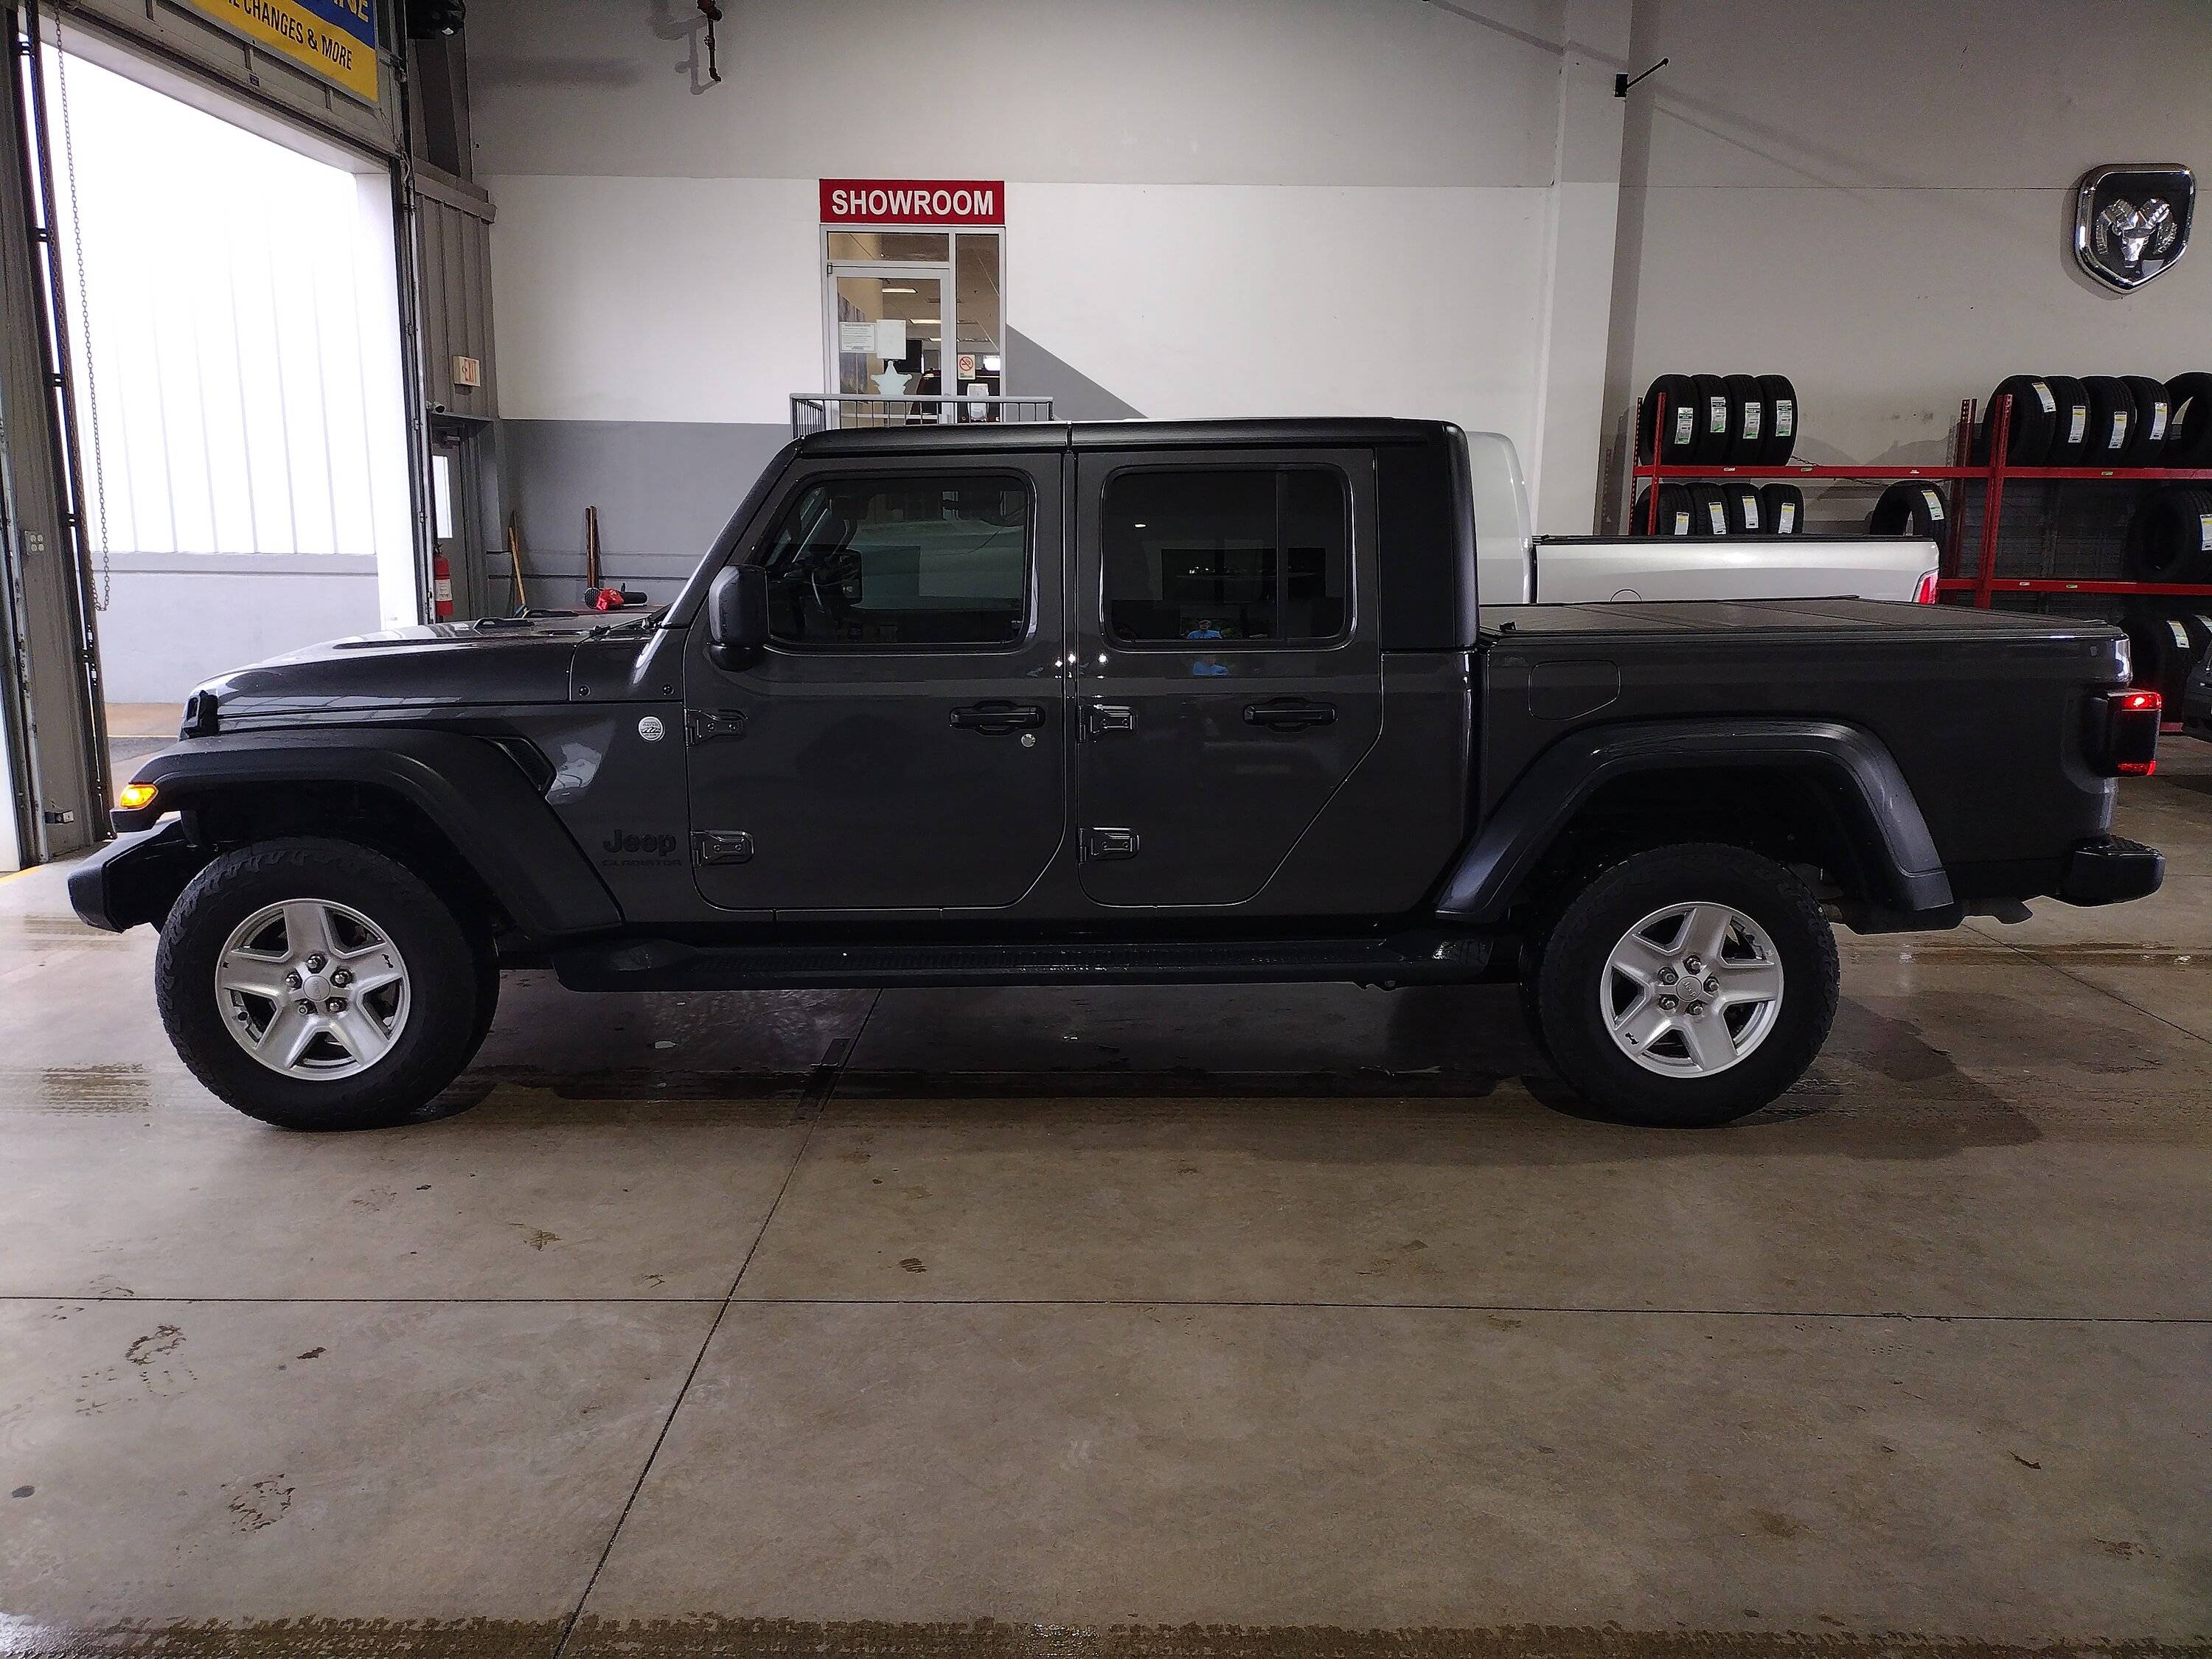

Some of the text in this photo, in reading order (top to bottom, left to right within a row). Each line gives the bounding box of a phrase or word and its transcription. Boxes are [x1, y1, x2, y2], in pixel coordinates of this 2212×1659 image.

[243, 0, 352, 70] CHANGES & MORE
[831, 189, 994, 215] SHOWROOM
[464, 358, 477, 383] EXIT
[602, 829, 676, 856] Jeep
